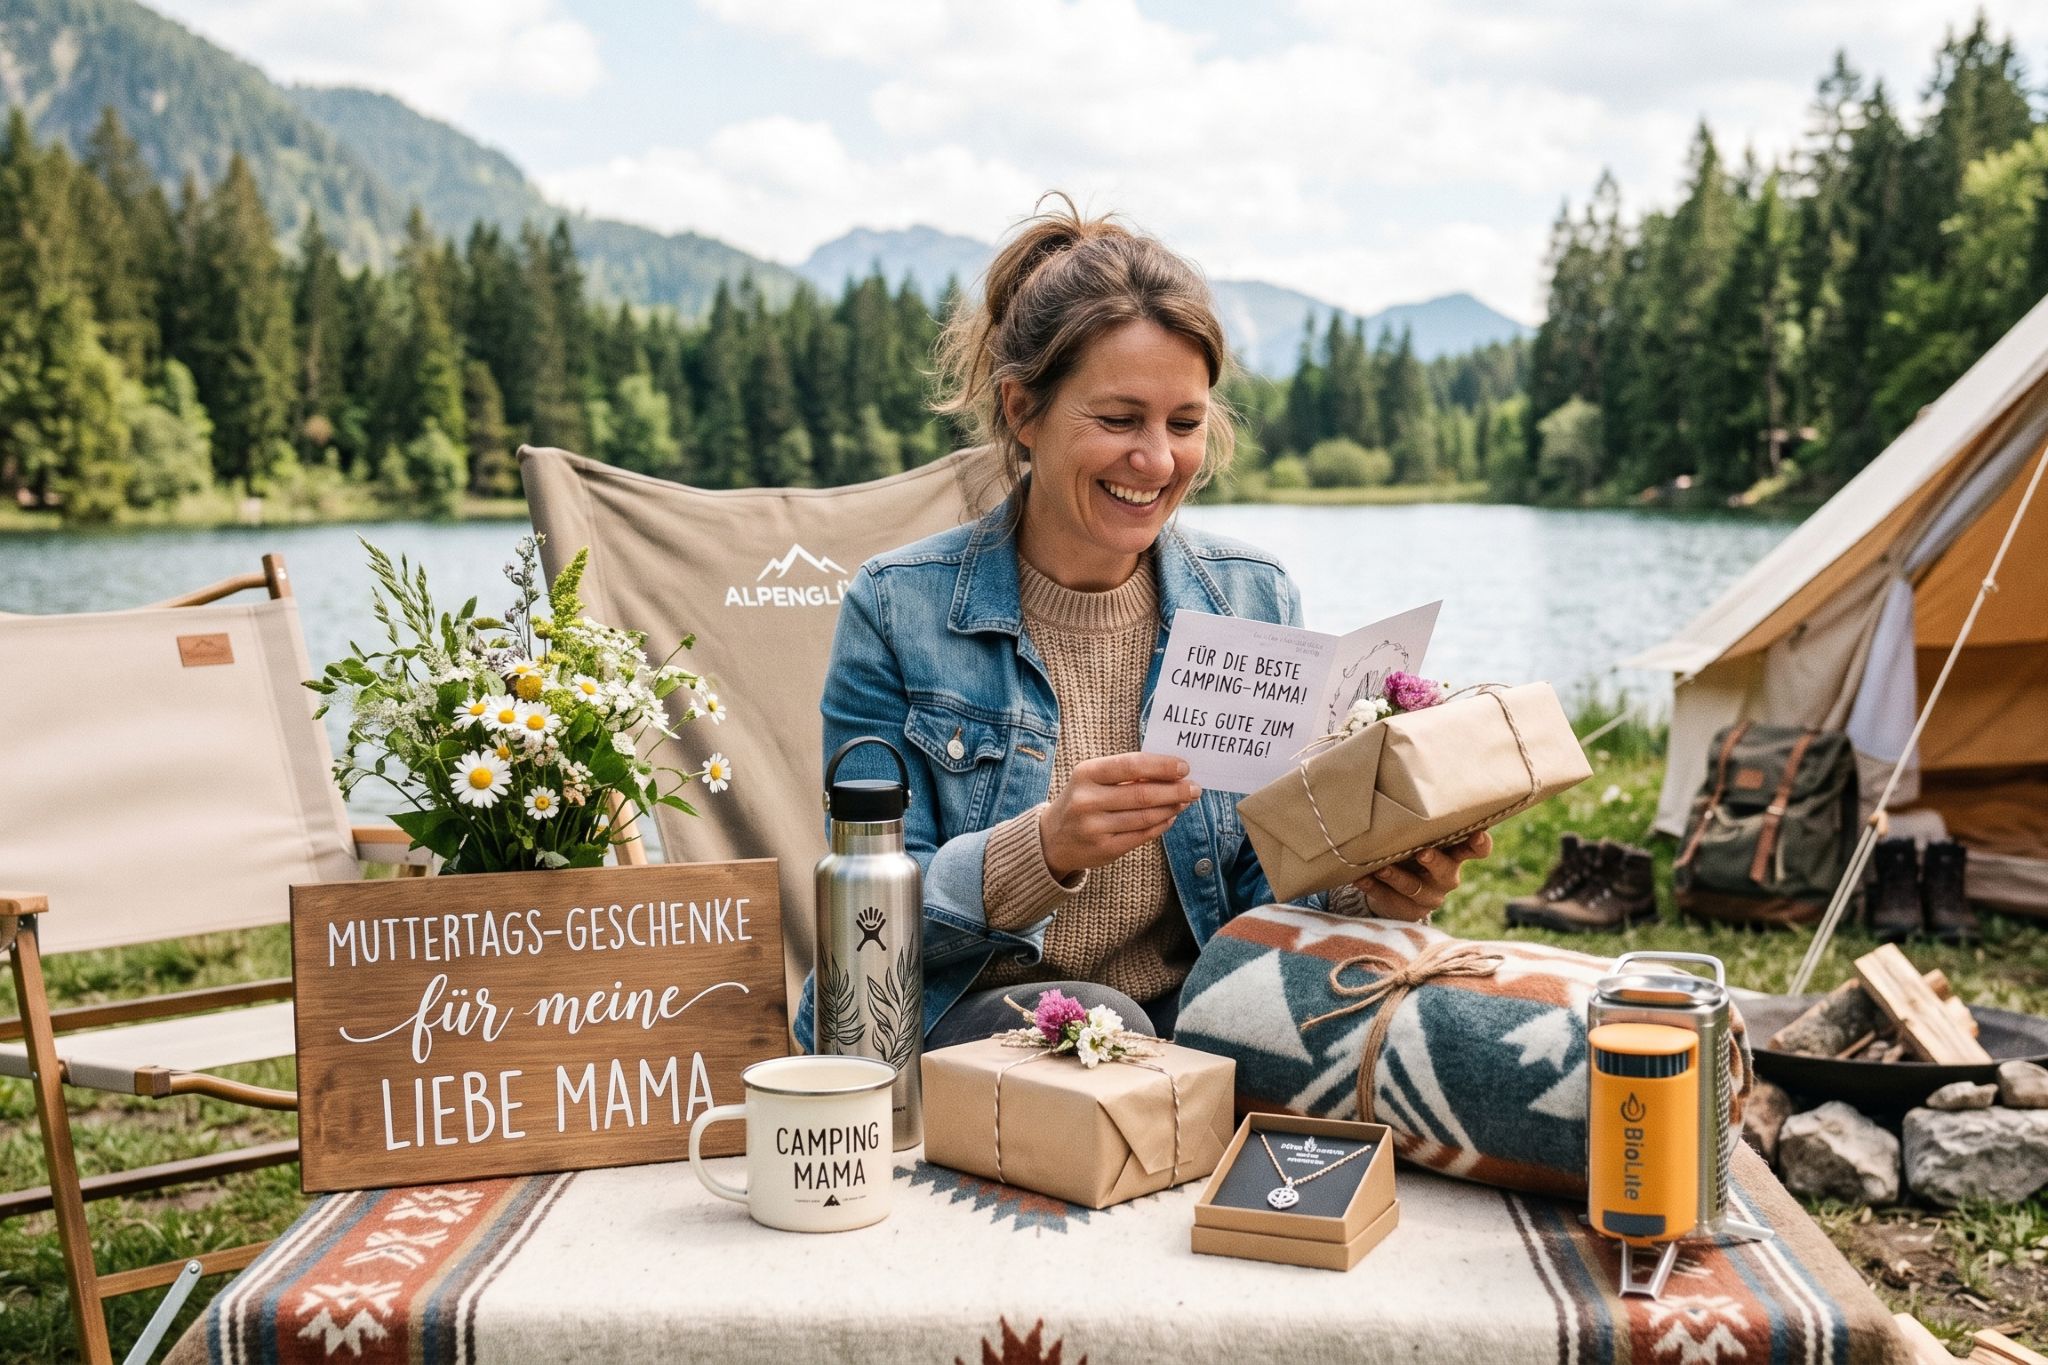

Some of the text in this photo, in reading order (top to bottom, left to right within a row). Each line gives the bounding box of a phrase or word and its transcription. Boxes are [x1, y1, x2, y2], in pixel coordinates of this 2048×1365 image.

[1187, 645, 1302, 681] FÜR DIE BESTE
[1171, 668, 1308, 706] CAMPING-MAMA!
[1163, 704, 1295, 739] ALLES GUTE ZUM
[1176, 730, 1272, 760] MUTTERTAG!
[328, 897, 753, 968] MUTTERTAGS-GESCHENKE
[338, 973, 750, 1065] für meine
[381, 1051, 716, 1152] LIEBE MAMA
[776, 1121, 880, 1156] CAMPING
[793, 1158, 867, 1190] MAMA
[1623, 1127, 1645, 1201] BioLite
